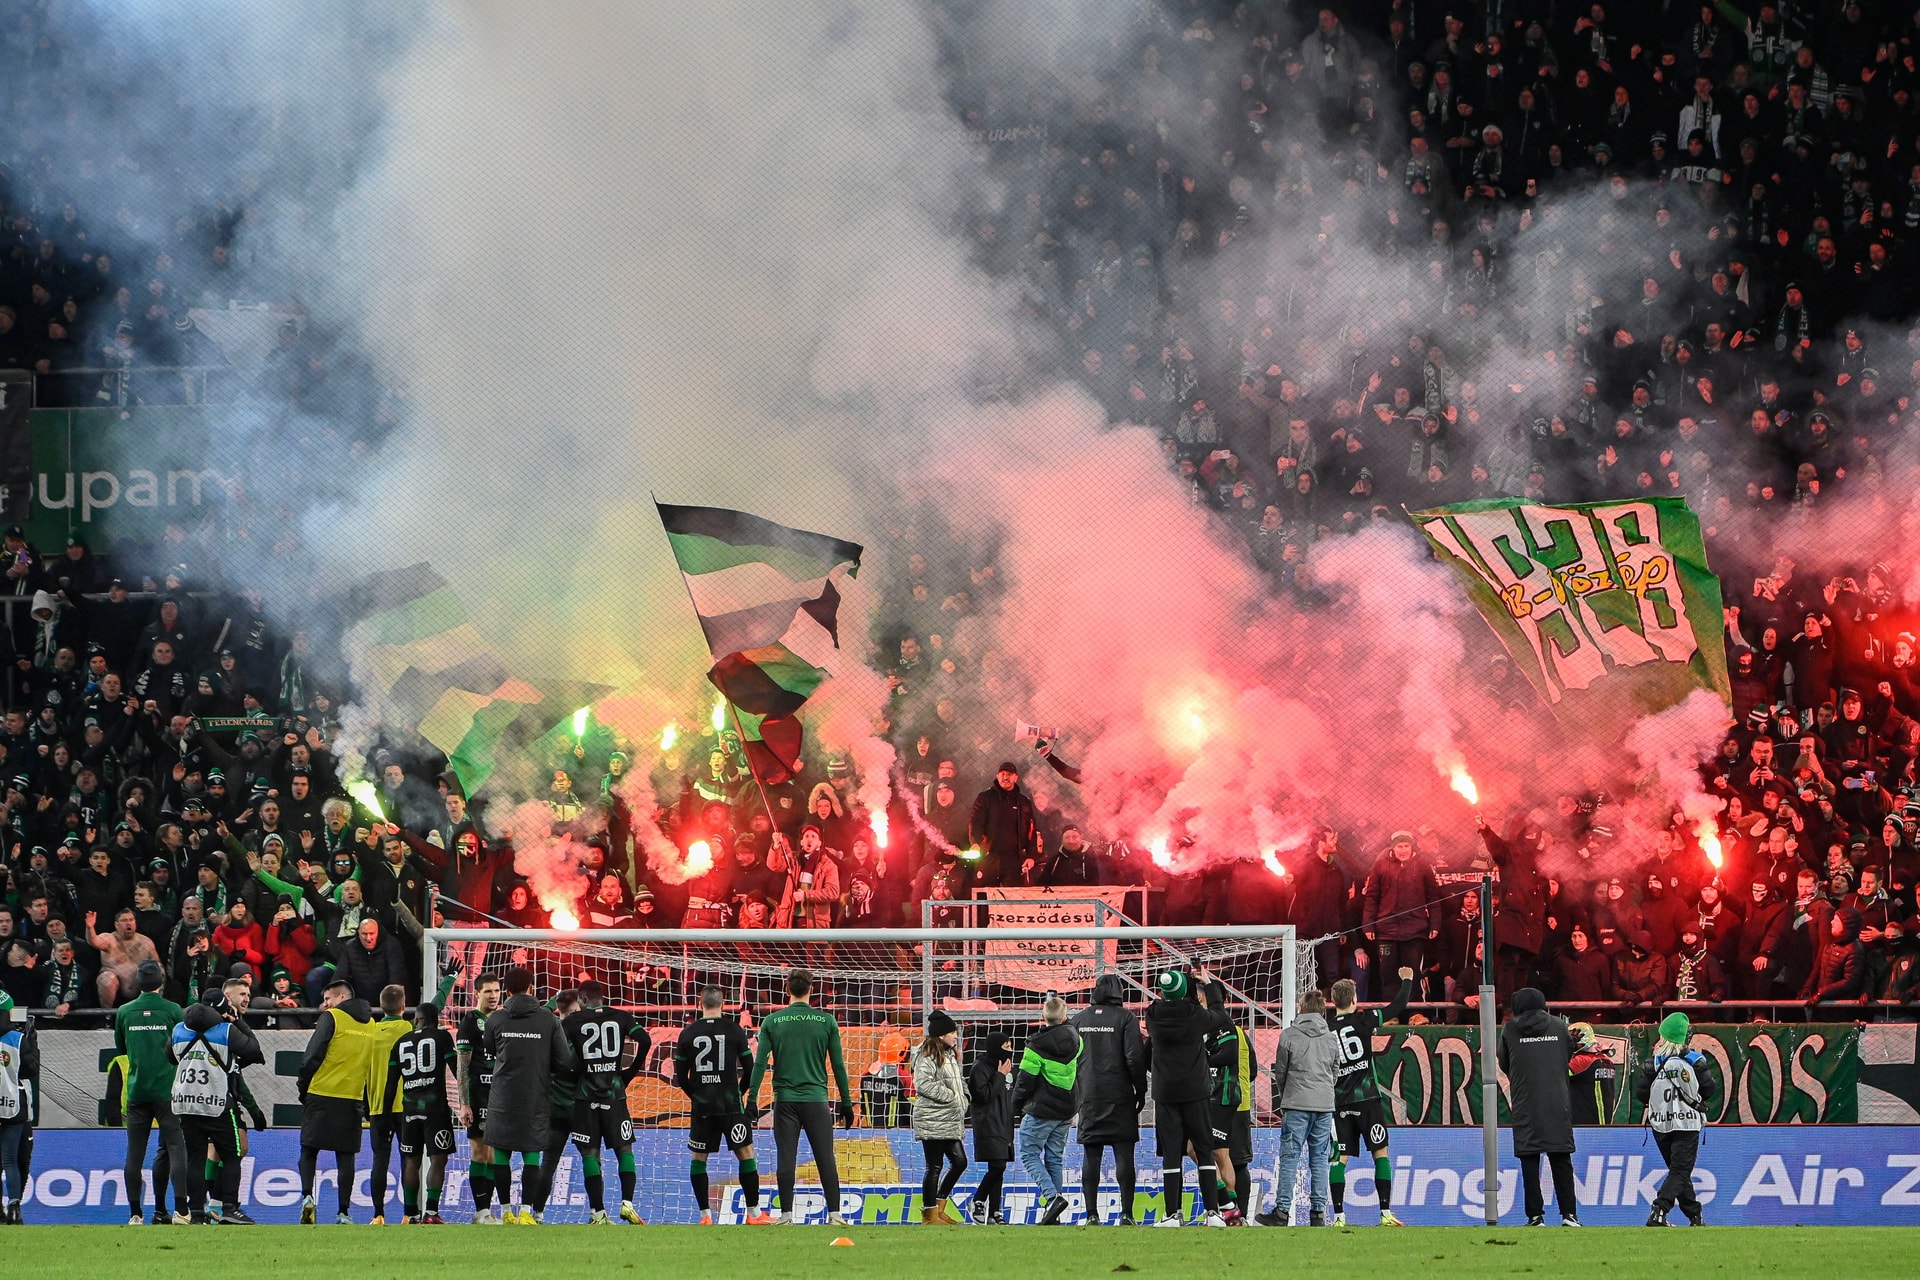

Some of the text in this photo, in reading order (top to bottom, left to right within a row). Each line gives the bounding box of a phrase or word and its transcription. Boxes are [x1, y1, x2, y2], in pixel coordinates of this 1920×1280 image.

[30, 469, 231, 522] upam
[399, 1037, 437, 1076] 50
[580, 1020, 621, 1060] 20
[693, 1034, 726, 1072] 21
[179, 1068, 209, 1085] 033
[701, 1074, 722, 1084] BOTKA
[1540, 1154, 1717, 1207] Nike
[1731, 1154, 1865, 1207] Air
